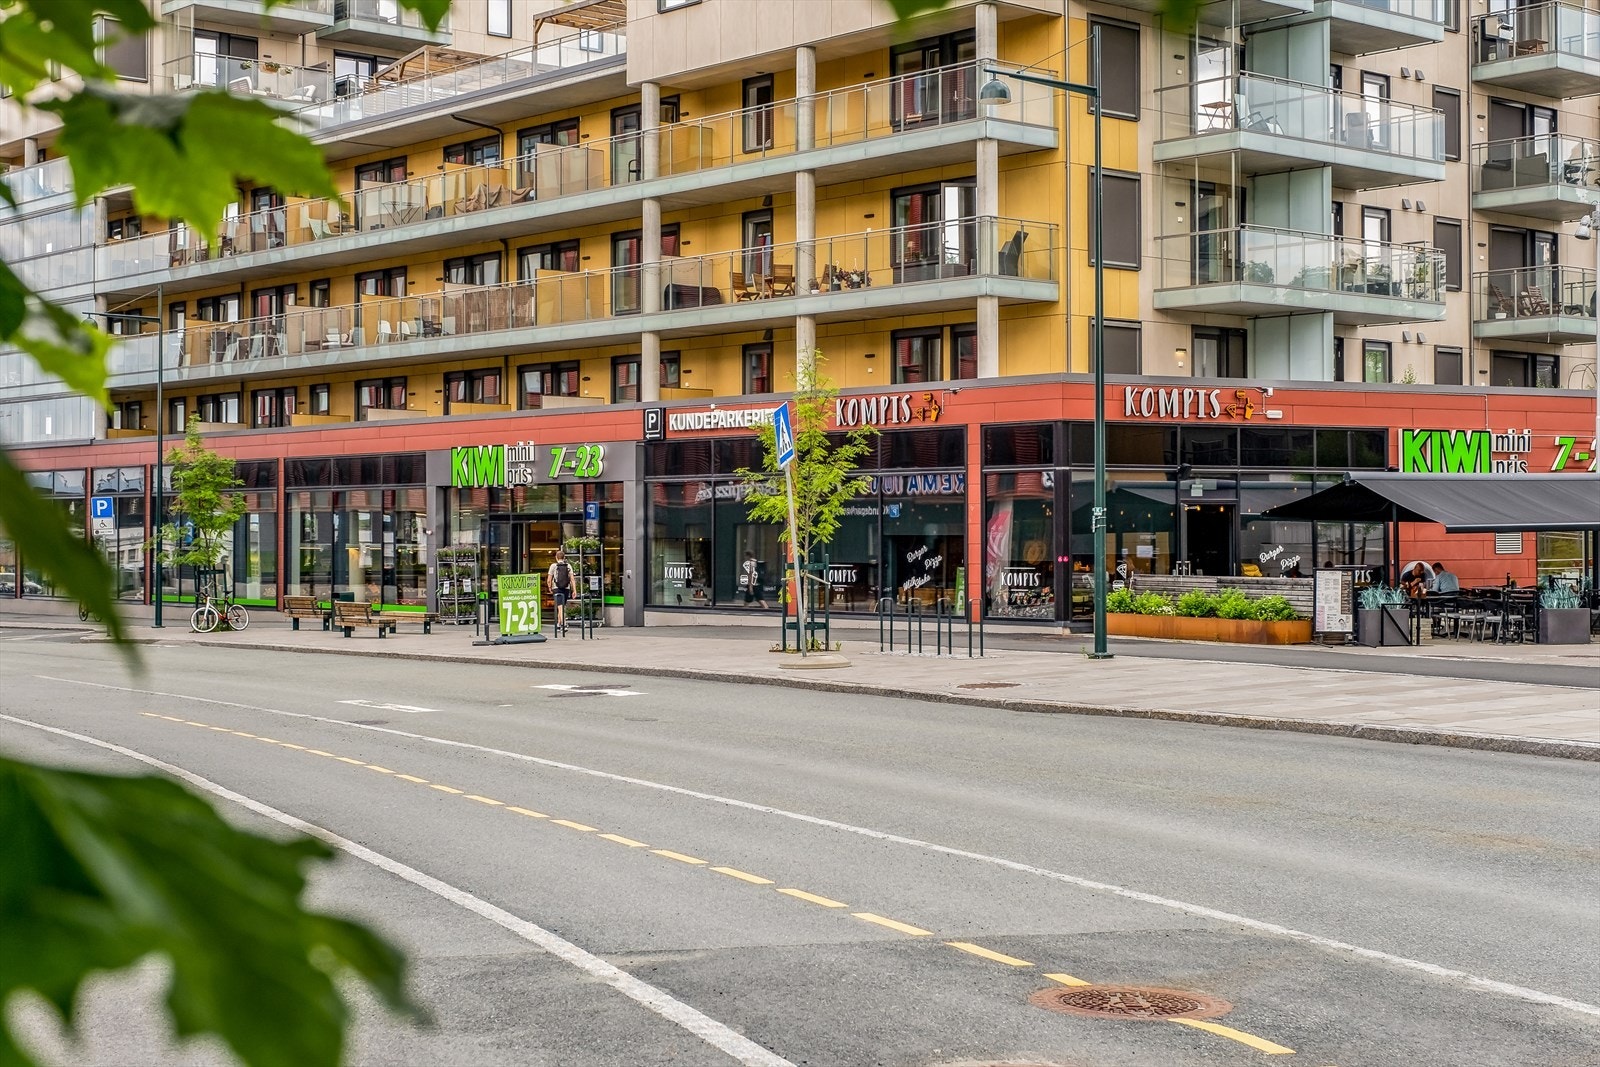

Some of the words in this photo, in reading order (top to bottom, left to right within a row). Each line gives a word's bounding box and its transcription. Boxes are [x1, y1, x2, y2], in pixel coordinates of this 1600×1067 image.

[836, 394, 911, 427] KOMPIS
[1124, 386, 1221, 418] KOMPIS
[648, 413, 657, 429] P
[669, 408, 775, 431] KUNDEPARKERI
[1400, 429, 1491, 473] KIWI
[1495, 430, 1531, 452] mini
[1551, 436, 1596, 471] 7-
[451, 445, 505, 488] KIWI
[507, 442, 534, 462] mini
[548, 445, 603, 478] 7-23
[507, 464, 532, 488] pris
[96, 500, 107, 516] P
[907, 545, 928, 563] Burger
[925, 555, 943, 570] Pizza
[1259, 545, 1284, 564] Burger
[1280, 554, 1301, 570] Pizza
[501, 576, 526, 589] KIWI
[664, 566, 692, 579] KOMPIS
[1001, 571, 1040, 586] KOMPIS
[503, 600, 538, 633] 7-23
